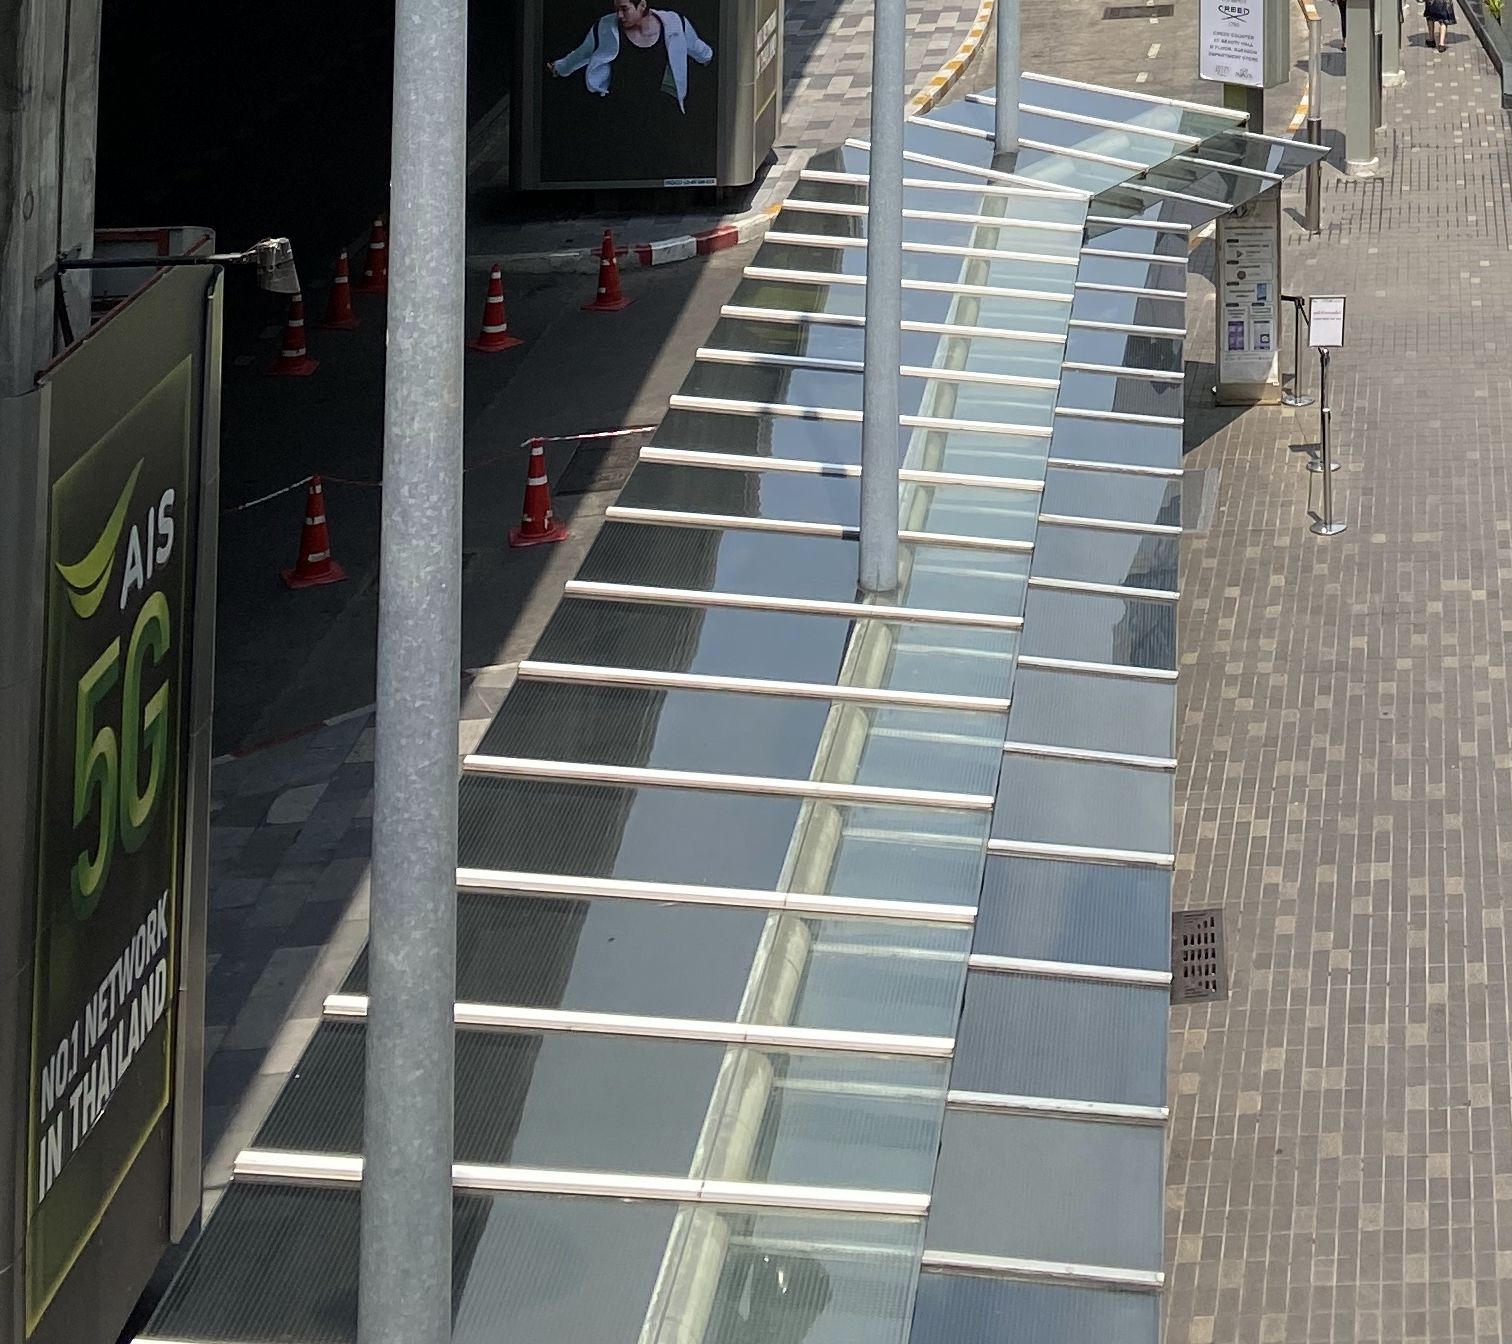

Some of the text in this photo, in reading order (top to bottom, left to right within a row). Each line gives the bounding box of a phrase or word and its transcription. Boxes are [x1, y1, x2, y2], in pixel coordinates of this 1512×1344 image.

[1218, 5, 1250, 16] CREED
[119, 487, 175, 610] AIS
[70, 589, 171, 921] 5G
[38, 972, 168, 1207] IN THAILAND
[41, 888, 170, 1124] NO.1 NETWORK
